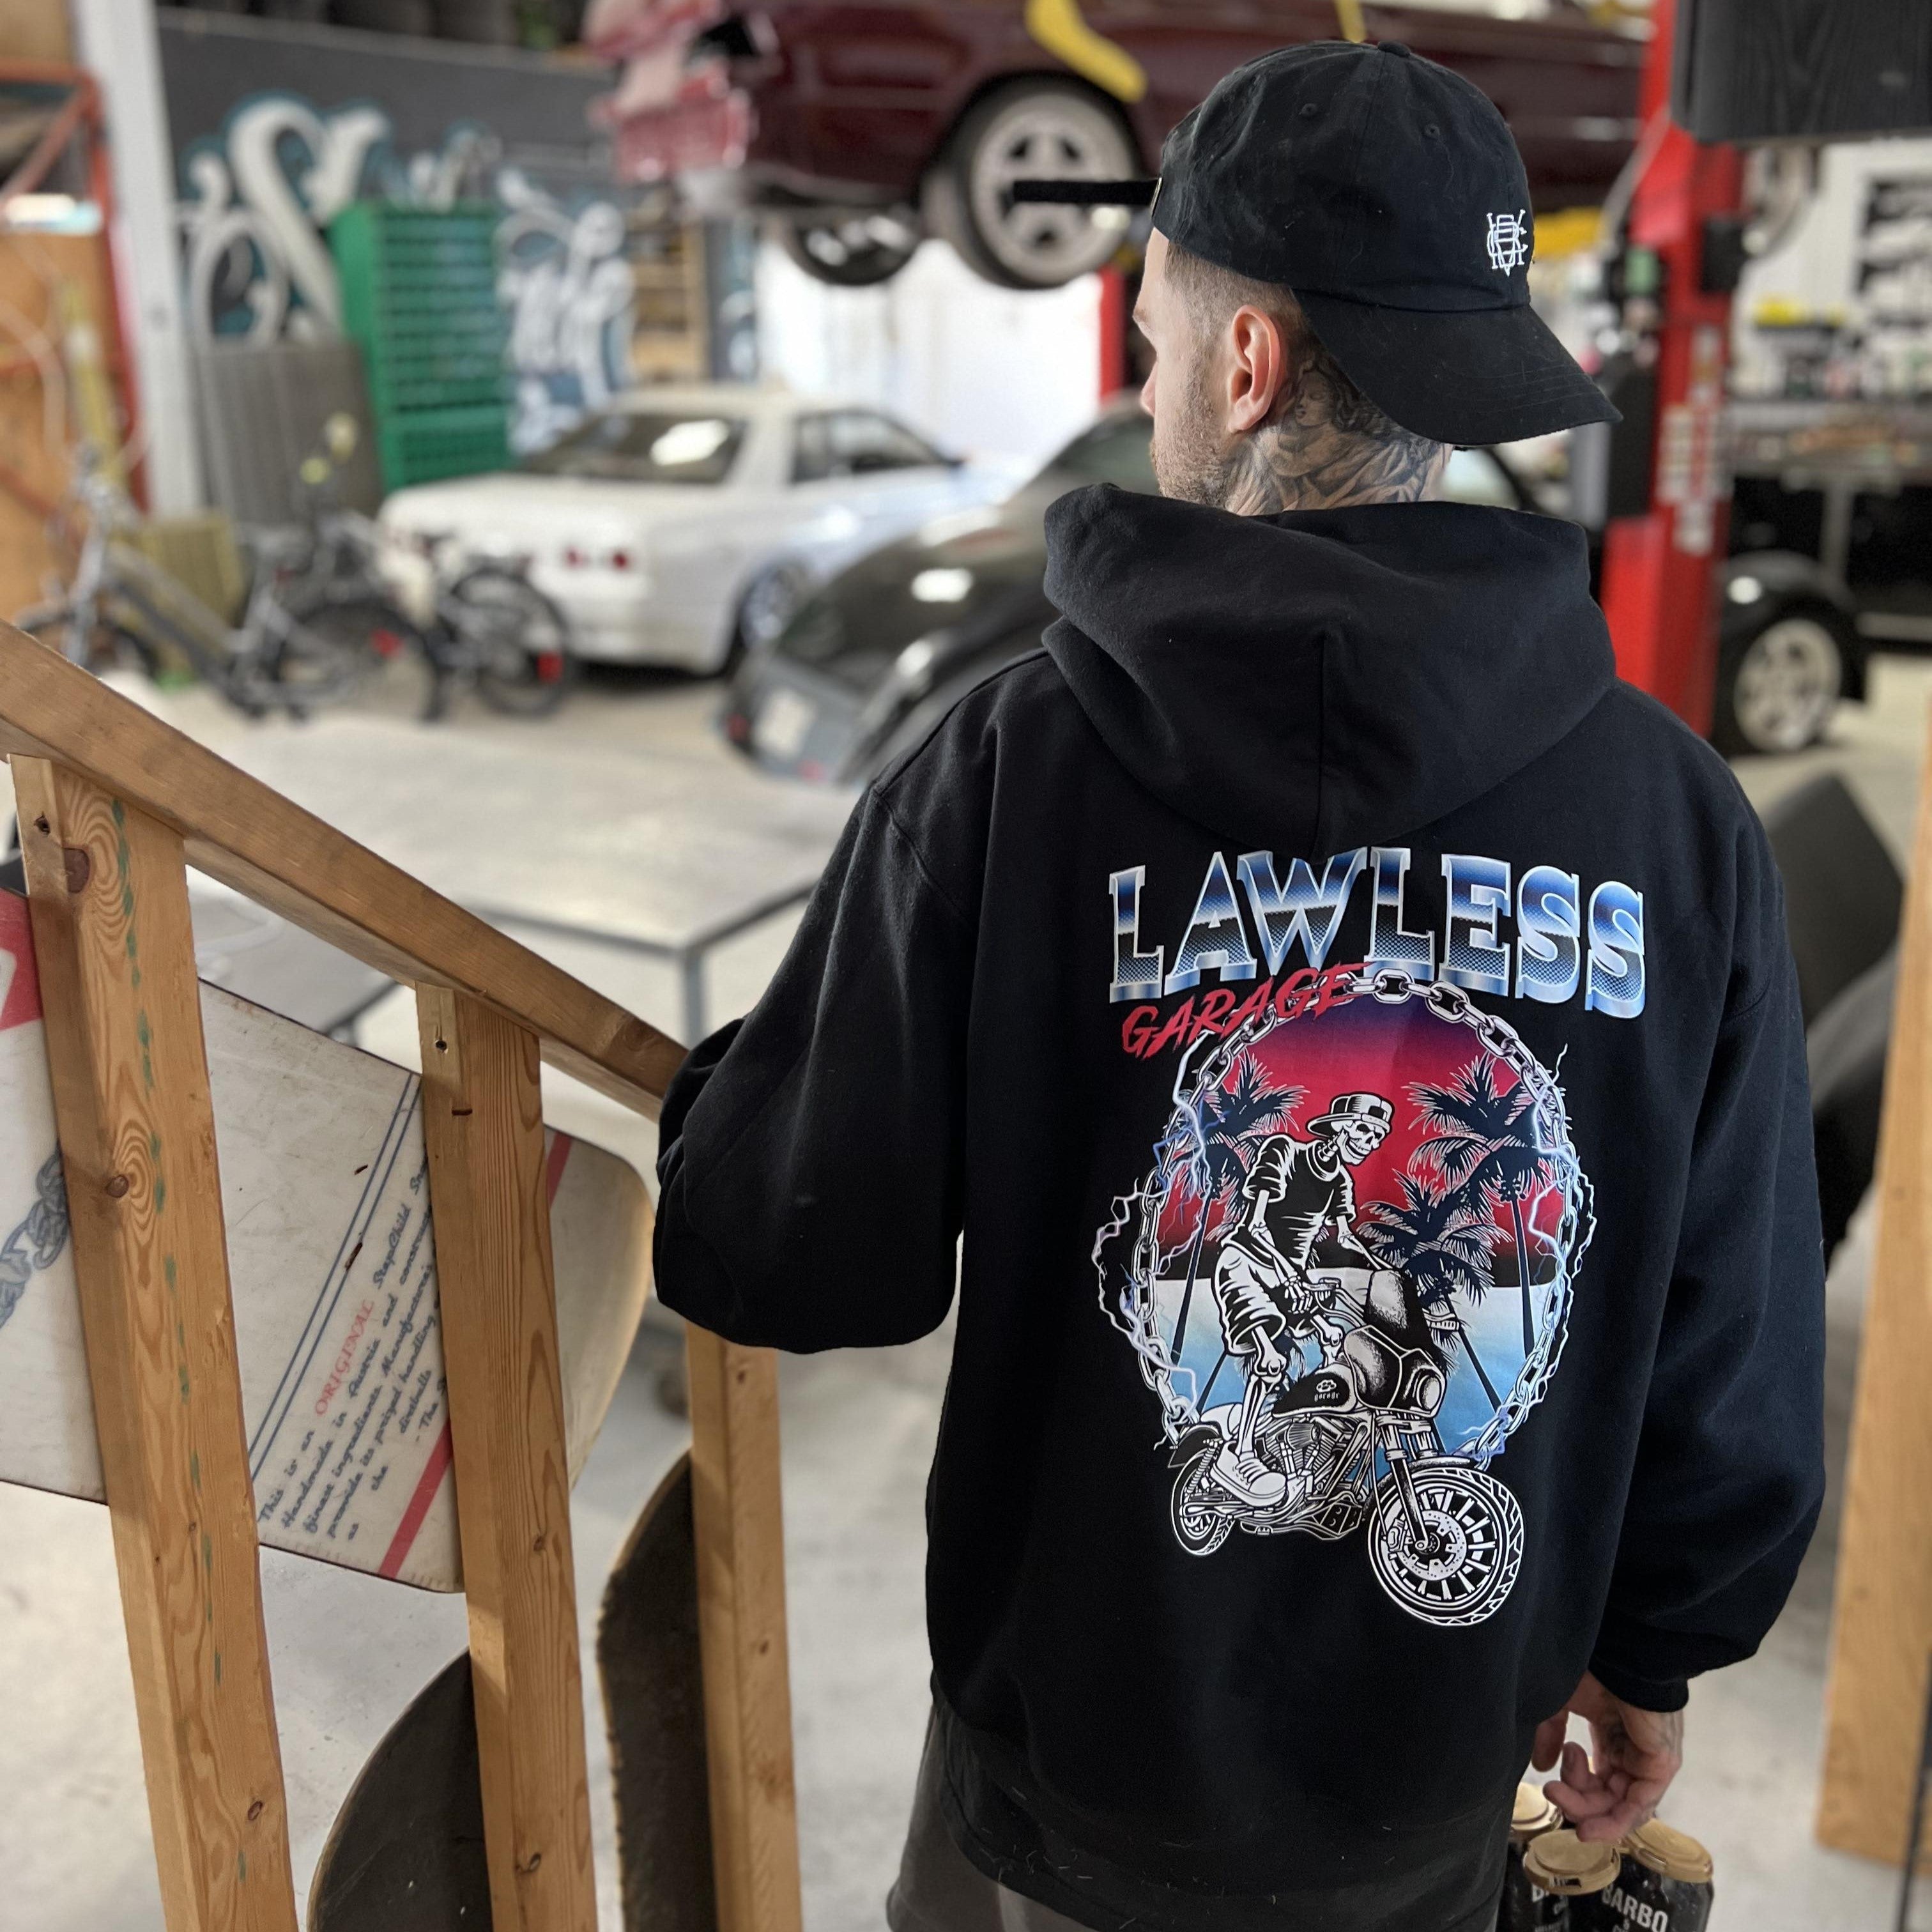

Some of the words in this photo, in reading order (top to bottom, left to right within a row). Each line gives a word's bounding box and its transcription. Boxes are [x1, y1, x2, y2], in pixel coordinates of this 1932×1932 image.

[1109, 847, 1646, 1019] LAWLESS
[1122, 961, 1374, 1060] GARAGE
[257, 1488, 284, 1520] This
[299, 1429, 315, 1452] an
[312, 1298, 374, 1416] ORIGINAL
[280, 1439, 334, 1528] Handmade
[330, 1411, 348, 1429] in
[381, 1292, 399, 1327] and
[397, 1314, 437, 1383] handling
